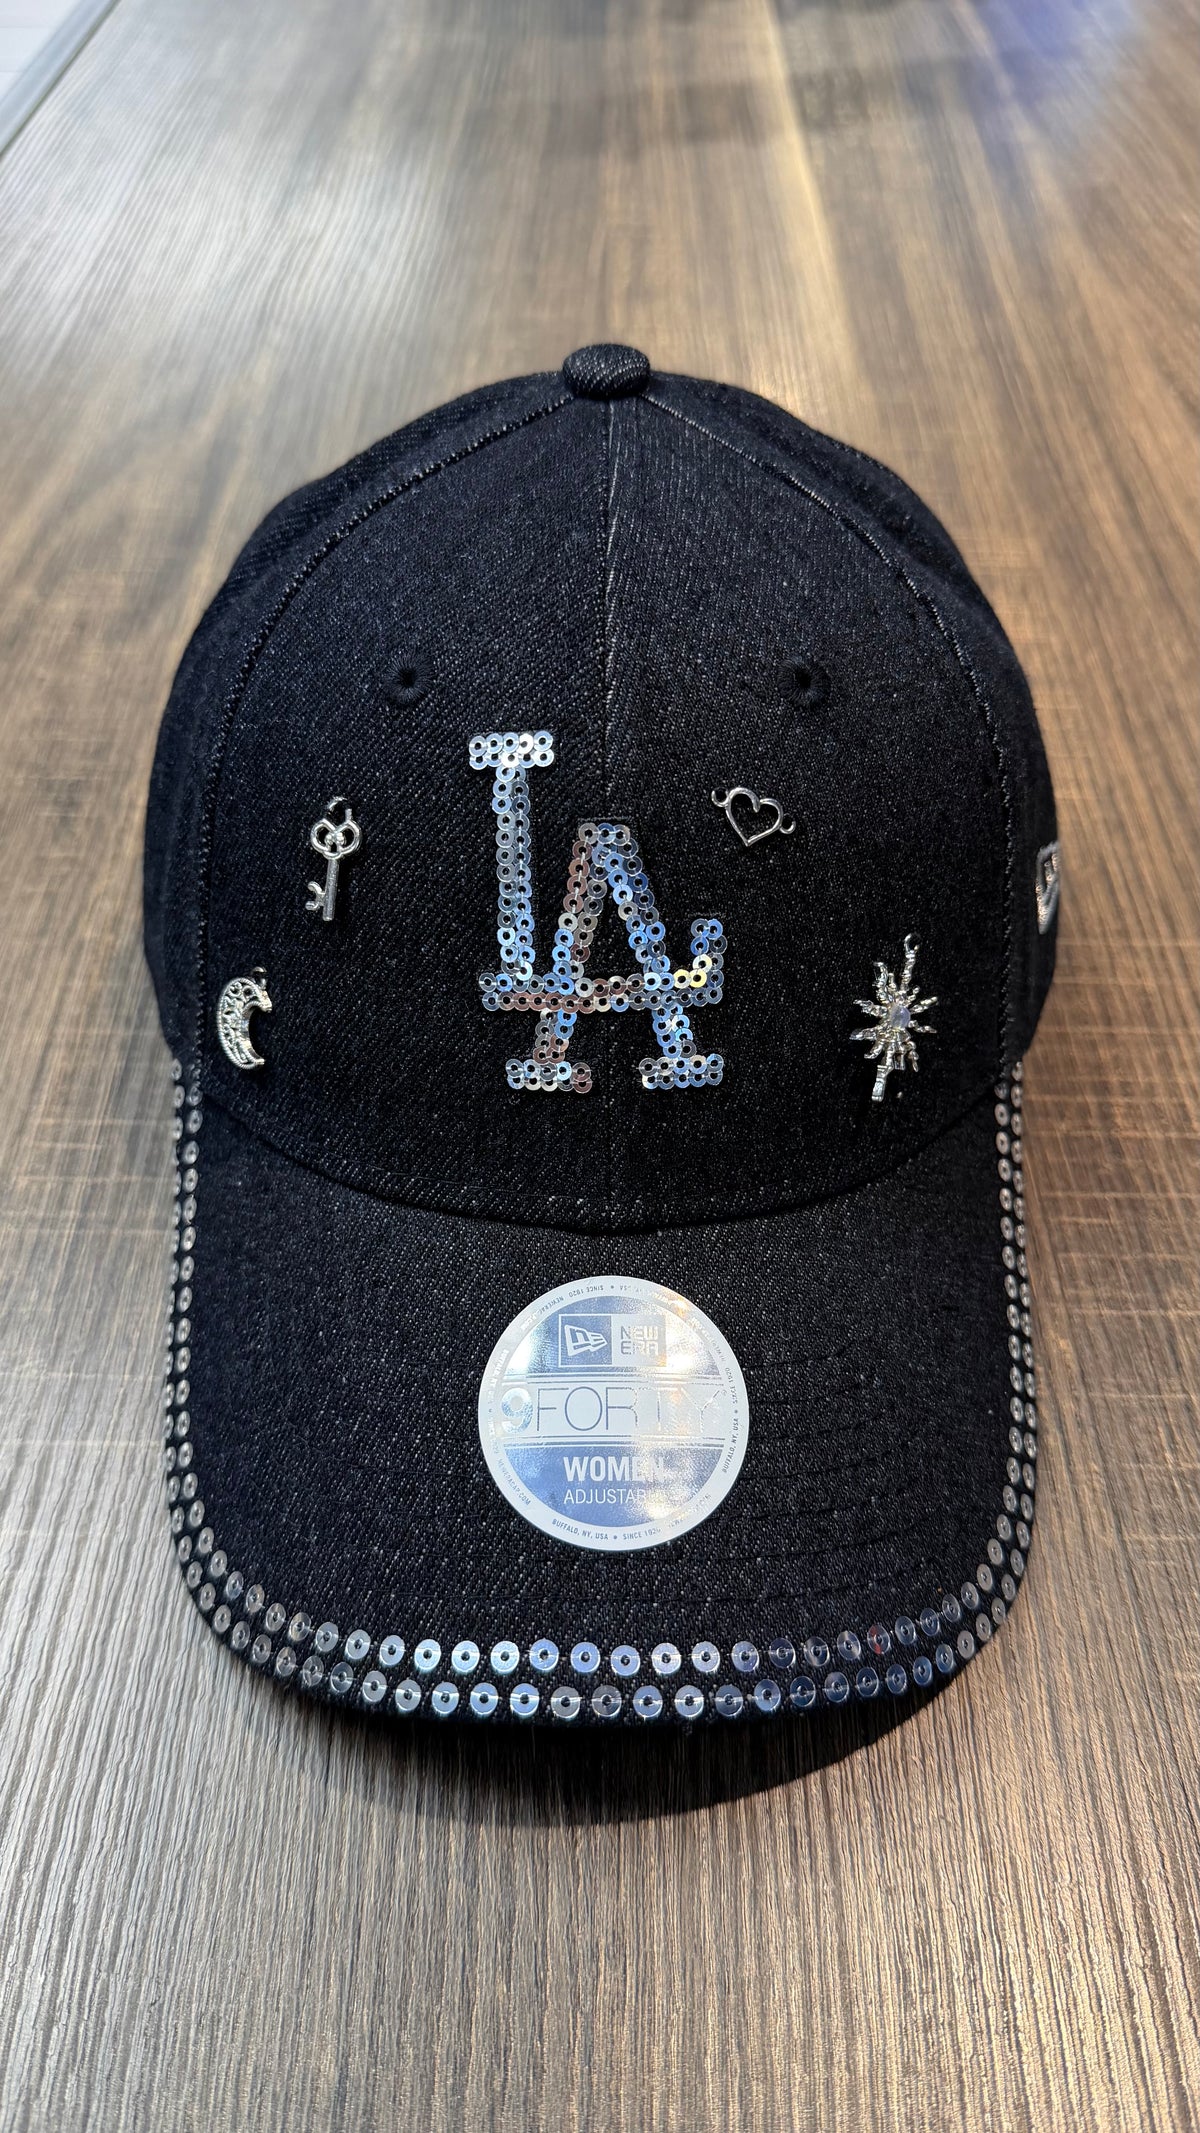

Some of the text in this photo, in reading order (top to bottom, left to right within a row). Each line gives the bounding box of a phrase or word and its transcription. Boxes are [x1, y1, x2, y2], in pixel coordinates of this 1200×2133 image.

[468, 731, 727, 1093] LA
[585, 1283, 604, 1293] SINCE
[620, 1325, 659, 1340] NEW
[620, 1340, 659, 1355] ERA
[500, 1386, 720, 1433] 9FORTY
[719, 1444, 736, 1473] BUFFALO,
[731, 1417, 739, 1430] USA
[563, 1456, 665, 1482] WOMEN
[563, 1488, 663, 1504] ADJUSTAB
[550, 1517, 581, 1536] BUFFALO,
[580, 1529, 593, 1539] NY,
[594, 1532, 609, 1540] USA
[622, 1530, 642, 1540] SINCE
